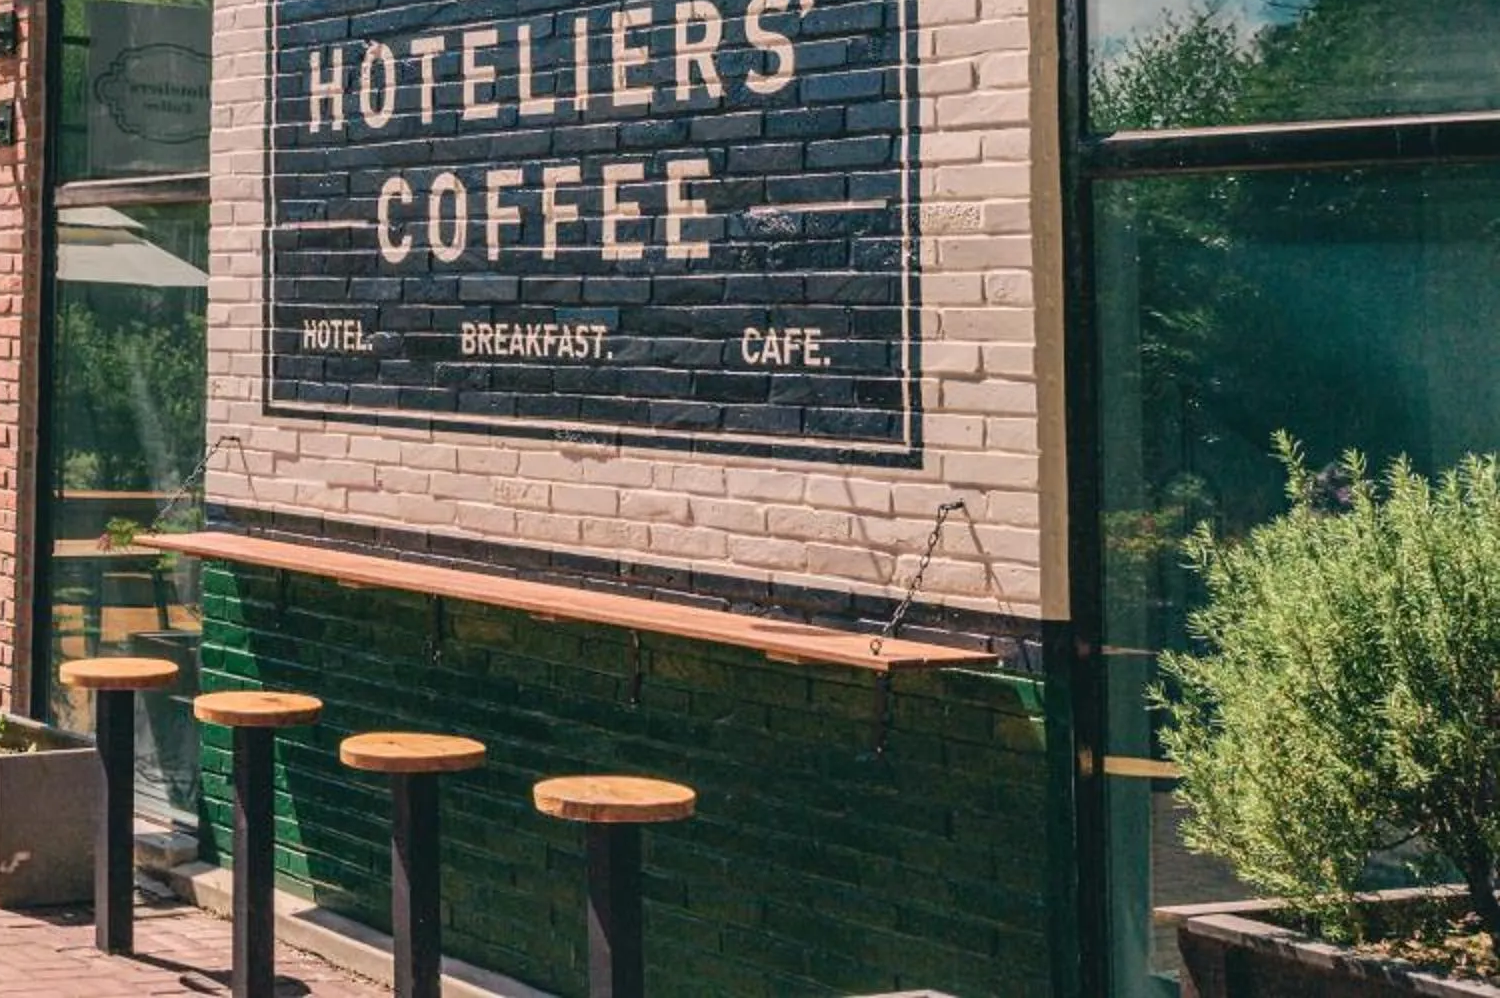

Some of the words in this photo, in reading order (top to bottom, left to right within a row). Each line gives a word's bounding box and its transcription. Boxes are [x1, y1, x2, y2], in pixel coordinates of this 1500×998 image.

[376, 158, 712, 264] COFFEE
[303, 319, 372, 350] HOTEL.
[461, 322, 613, 360] BREAKFAST.
[741, 326, 831, 366] CAFE.
